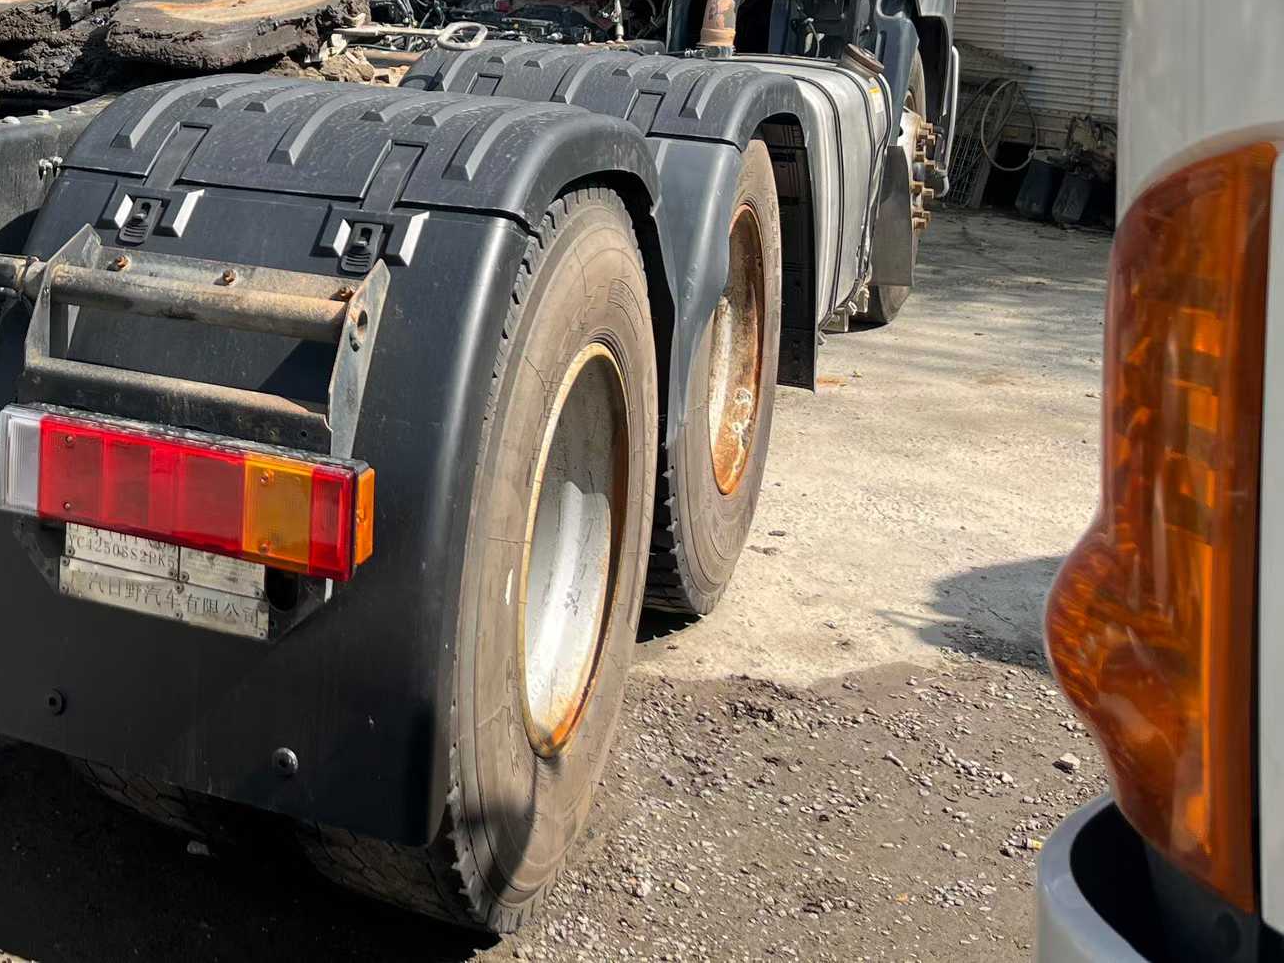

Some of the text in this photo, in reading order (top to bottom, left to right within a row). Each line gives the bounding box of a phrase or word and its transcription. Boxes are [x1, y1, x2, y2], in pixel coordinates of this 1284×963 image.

[69, 569, 261, 629] 广汽日野汽车有限公司
